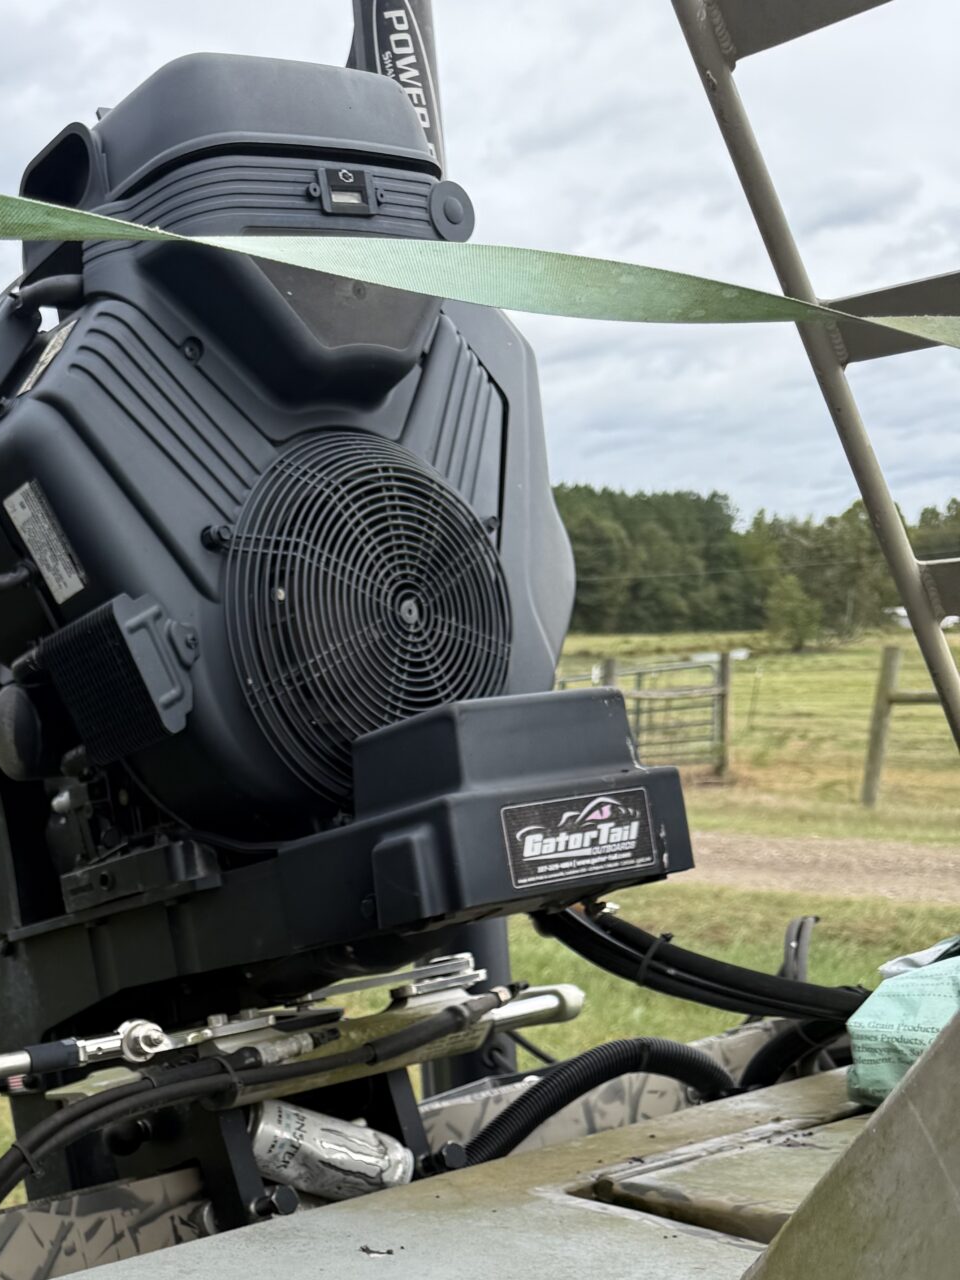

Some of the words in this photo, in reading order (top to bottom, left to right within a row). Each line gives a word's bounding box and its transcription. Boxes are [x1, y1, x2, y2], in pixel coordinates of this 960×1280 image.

[522, 821, 640, 858] GatorTail
[867, 1021, 894, 1030] Grain
[881, 1033, 927, 1046] Products,
